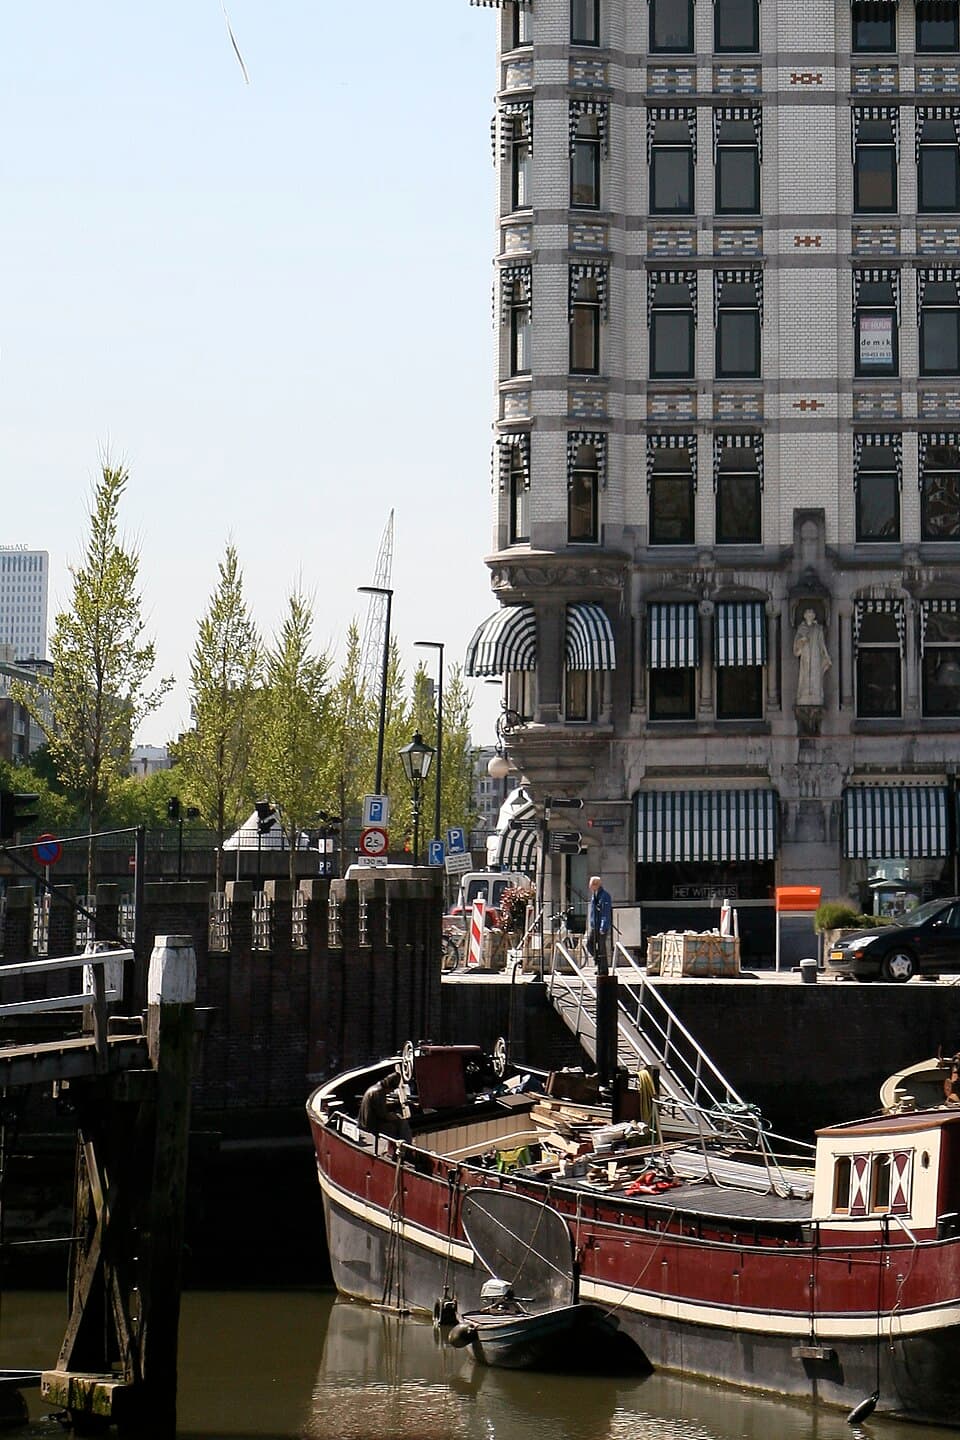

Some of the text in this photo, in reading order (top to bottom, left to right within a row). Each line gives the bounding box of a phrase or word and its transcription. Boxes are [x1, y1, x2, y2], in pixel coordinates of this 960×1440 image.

[371, 804, 381, 816] P
[450, 831, 461, 845] P
[432, 843, 441, 856] P
[675, 887, 690, 897] HET
